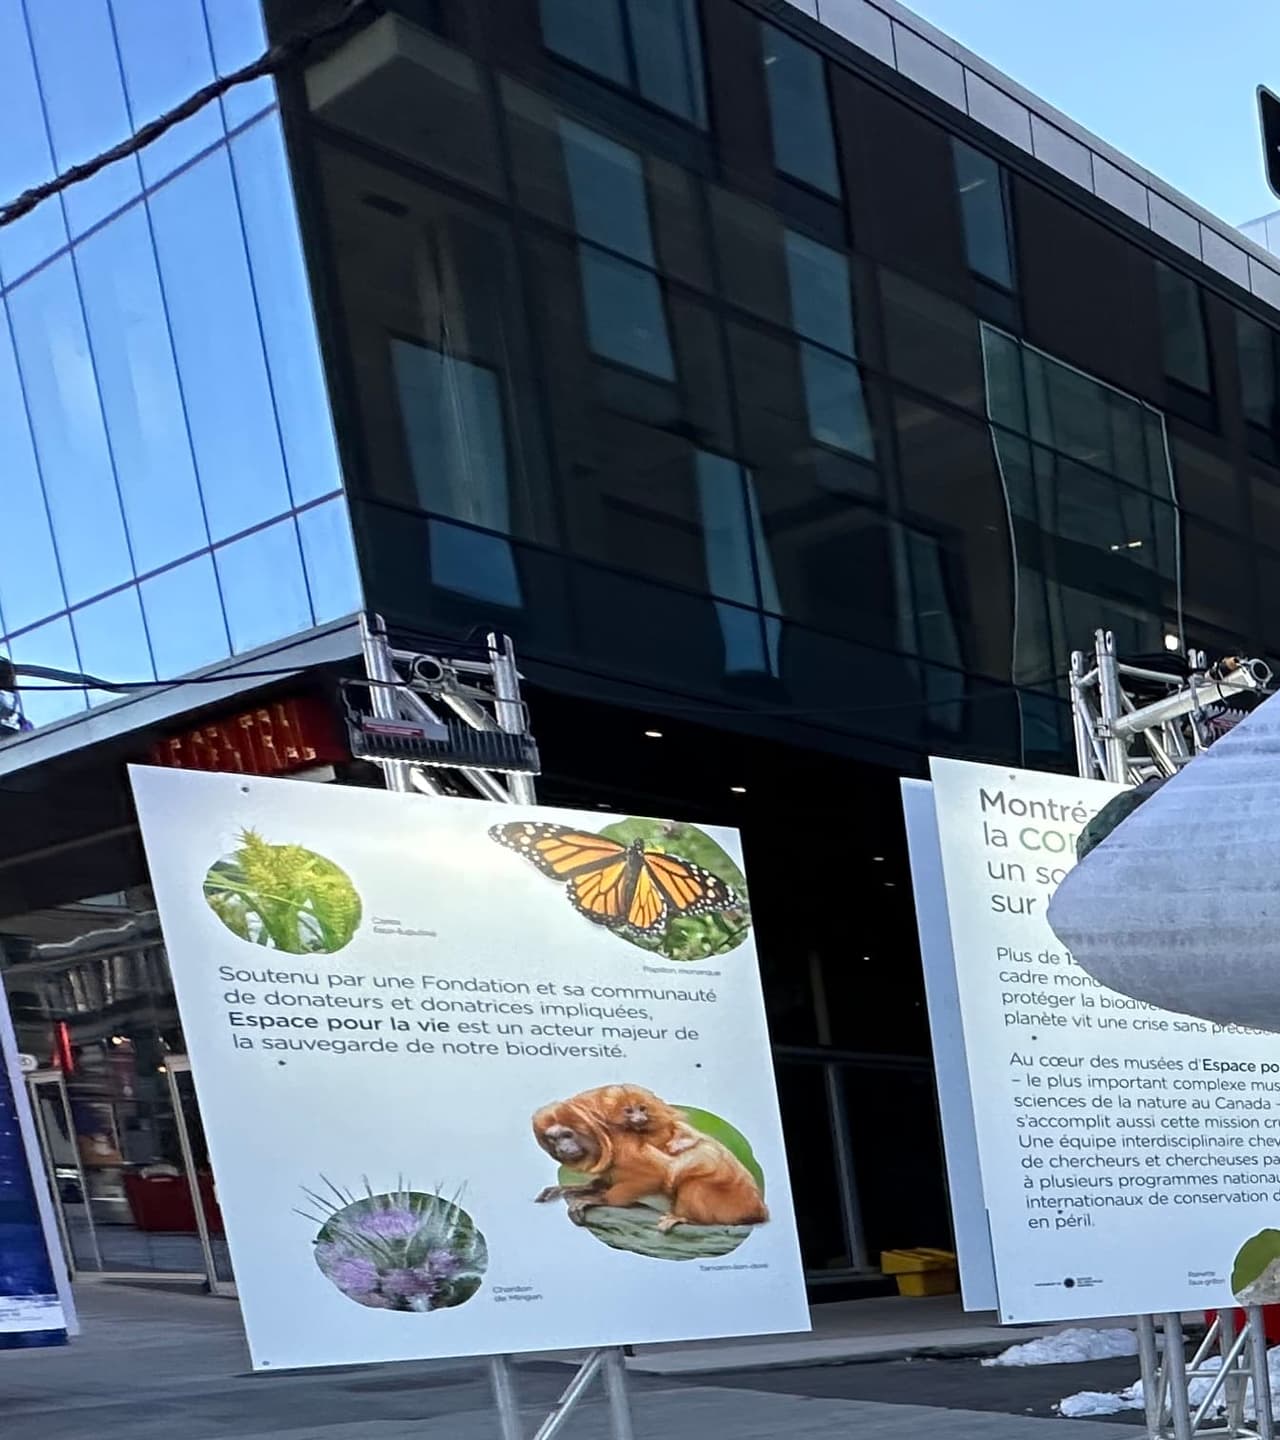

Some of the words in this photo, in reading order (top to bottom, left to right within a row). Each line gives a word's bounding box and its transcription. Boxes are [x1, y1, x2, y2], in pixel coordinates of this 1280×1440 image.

[983, 821, 1008, 847] la
[988, 861, 1025, 882] un
[991, 894, 1036, 915] sur
[997, 947, 1033, 964] Plus
[1038, 950, 1060, 965] de
[218, 966, 319, 986] Soutenu
[327, 975, 366, 991] par
[373, 976, 415, 989] une
[422, 975, 530, 995] Fondation
[536, 982, 557, 995] et
[562, 984, 585, 997] sa
[590, 984, 717, 1003] communauté
[999, 970, 1048, 985] cadre
[224, 988, 256, 1005] de
[264, 990, 384, 1009] donateurs
[390, 996, 415, 1010] et
[421, 996, 534, 1015] donatrices
[540, 1001, 653, 1022] impliquées,
[1002, 991, 1075, 1009] protéger
[1081, 993, 1095, 1007] la
[229, 1012, 319, 1032] Espace
[327, 1018, 383, 1033] pour
[390, 1016, 410, 1031] la
[417, 1018, 450, 1032] vie
[457, 1020, 491, 1034] est
[497, 1024, 523, 1035] un
[531, 1023, 594, 1037] acteur
[602, 1025, 668, 1041] majeur
[675, 1026, 699, 1040] de
[1004, 1011, 1068, 1028] planète
[1072, 1014, 1092, 1028] vit
[1098, 1016, 1128, 1029] une
[1132, 1017, 1169, 1031] crise
[1173, 1019, 1208, 1033] sans
[233, 1033, 255, 1049] la
[261, 1037, 399, 1057] sauvegarde
[406, 1038, 435, 1054] de
[442, 1041, 499, 1055] notre
[504, 1041, 627, 1058] biodiversité.
[1009, 1052, 1034, 1066] Au
[1039, 1056, 1084, 1067] cœur
[1090, 1054, 1119, 1068] des
[1124, 1056, 1183, 1071] musées
[1027, 1073, 1041, 1087] le
[1047, 1073, 1082, 1090] plus
[1088, 1074, 1168, 1091] important
[1173, 1078, 1246, 1093] complexe
[1014, 1095, 1087, 1108] sciences
[1091, 1094, 1113, 1108] de
[1118, 1094, 1131, 1108] la
[1137, 1097, 1187, 1109] nature
[1192, 1099, 1210, 1110] au
[1215, 1096, 1271, 1110] Canada
[1016, 1113, 1112, 1130] s'accomplit
[1116, 1114, 1156, 1128] aussi
[1160, 1116, 1200, 1129] cette
[1204, 1115, 1260, 1128] mission
[1019, 1134, 1054, 1148] Une
[1059, 1134, 1117, 1152] équipe
[1121, 1134, 1244, 1151] interdisciplinaire
[1021, 1155, 1044, 1169] de
[1049, 1153, 1141, 1168] chercheurs
[1145, 1154, 1161, 1167] et
[1165, 1152, 1258, 1167] chercheuses
[1024, 1174, 1034, 1189] à
[1039, 1174, 1113, 1191] plusieurs
[1118, 1175, 1218, 1191] programmes
[1026, 1192, 1143, 1207] internationaux
[1148, 1190, 1169, 1205] de
[1173, 1188, 1268, 1203] conservation
[1028, 1217, 1050, 1229] en
[1055, 1213, 1095, 1232] péril.
